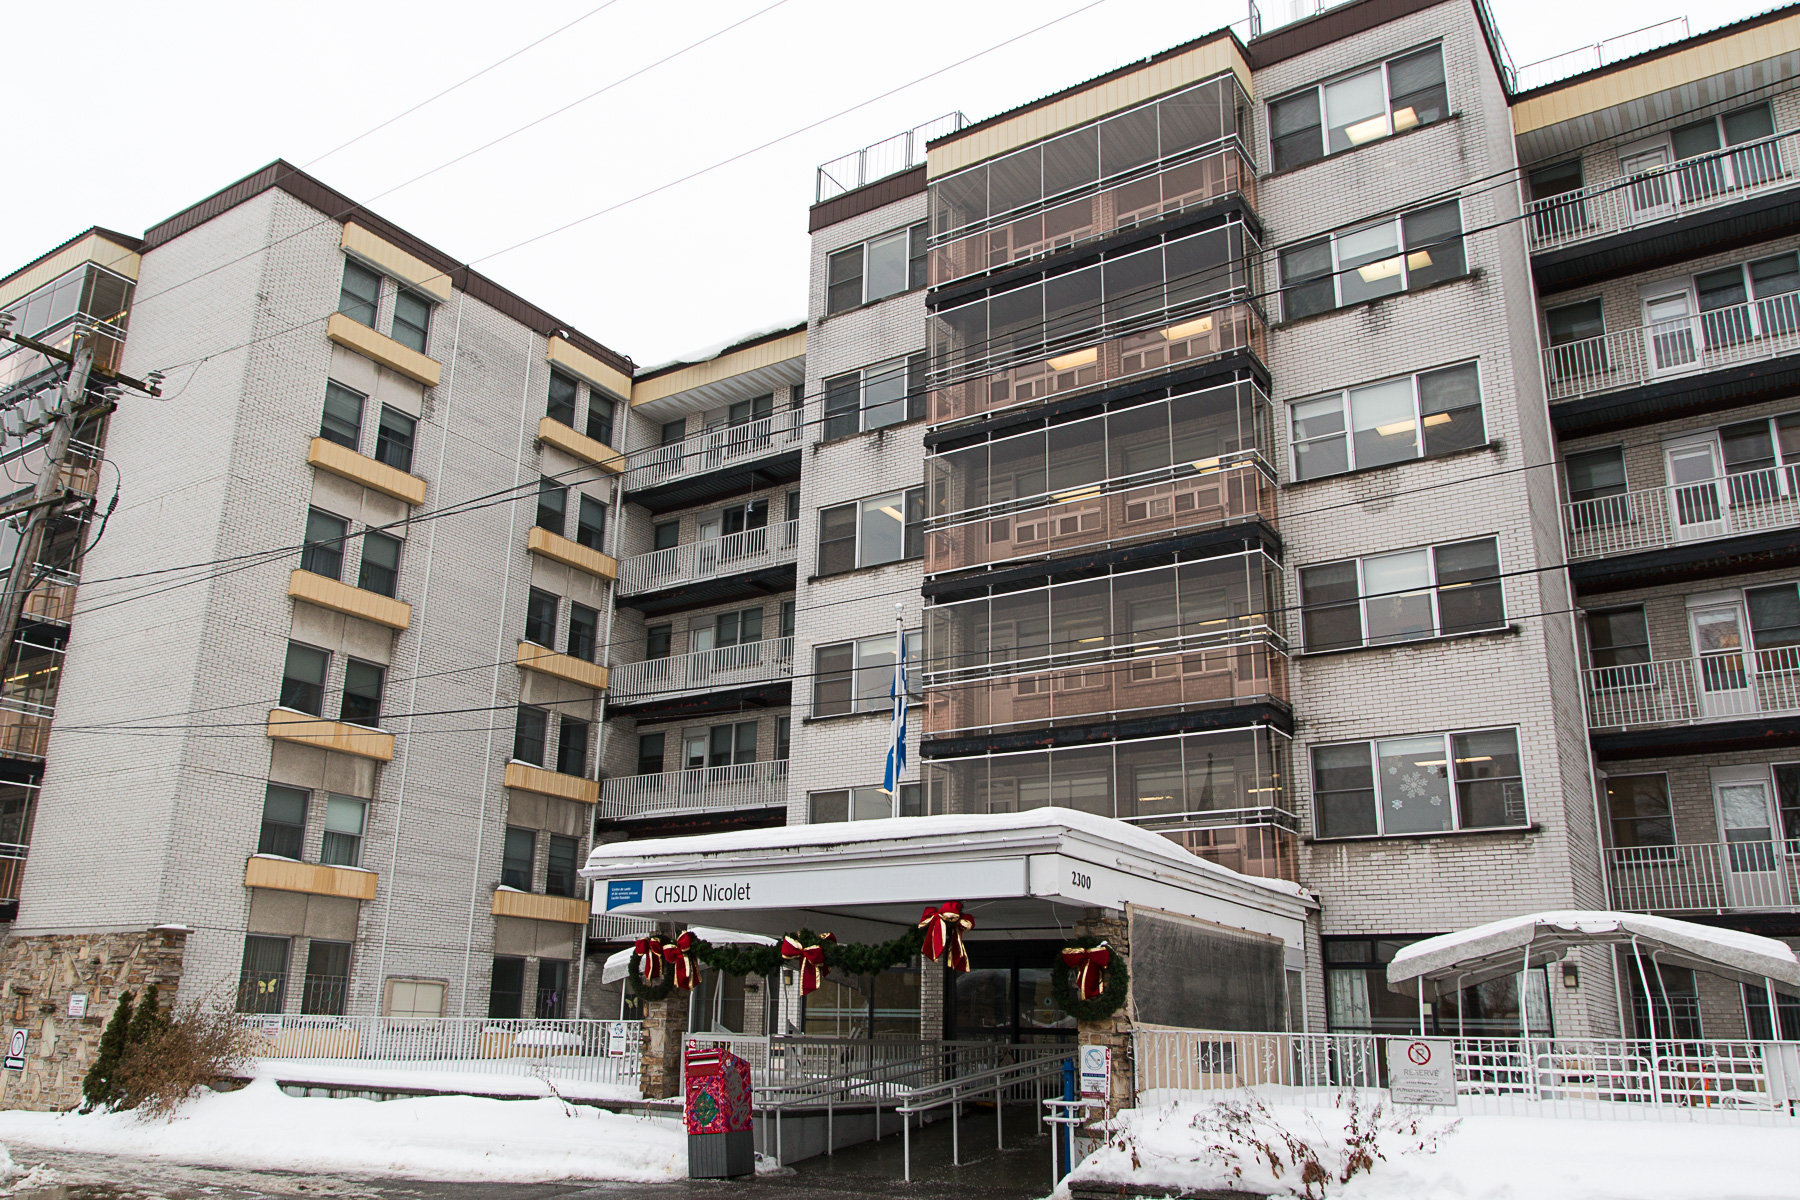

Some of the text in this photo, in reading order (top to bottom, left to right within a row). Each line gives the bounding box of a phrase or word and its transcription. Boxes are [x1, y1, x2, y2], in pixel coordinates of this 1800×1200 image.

[1071, 871, 1091, 889] 2300
[655, 882, 751, 904] CHSLD Nicolet
